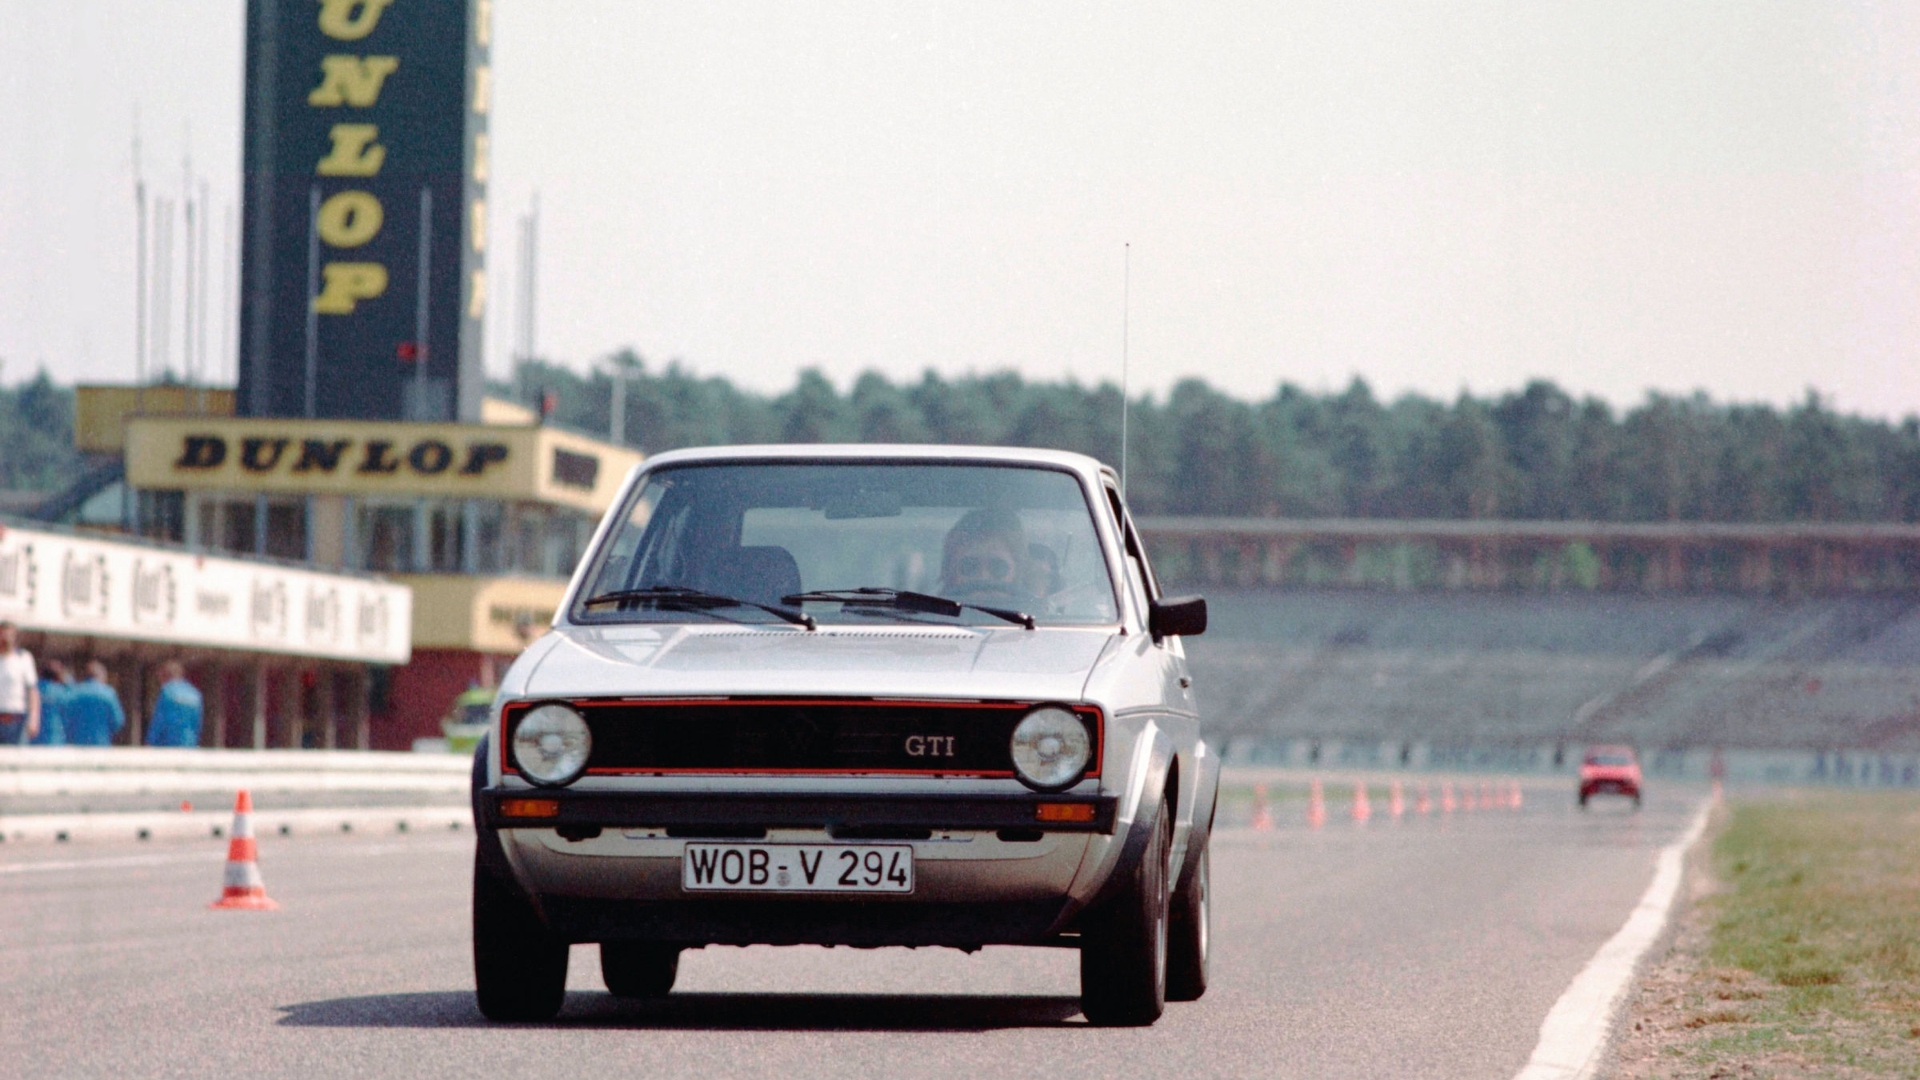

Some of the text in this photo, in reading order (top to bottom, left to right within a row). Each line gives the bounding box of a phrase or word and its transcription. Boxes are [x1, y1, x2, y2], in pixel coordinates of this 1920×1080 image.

[173, 434, 510, 476] DUNLOP
[904, 735, 955, 757] GTI
[837, 851, 908, 887] 294
